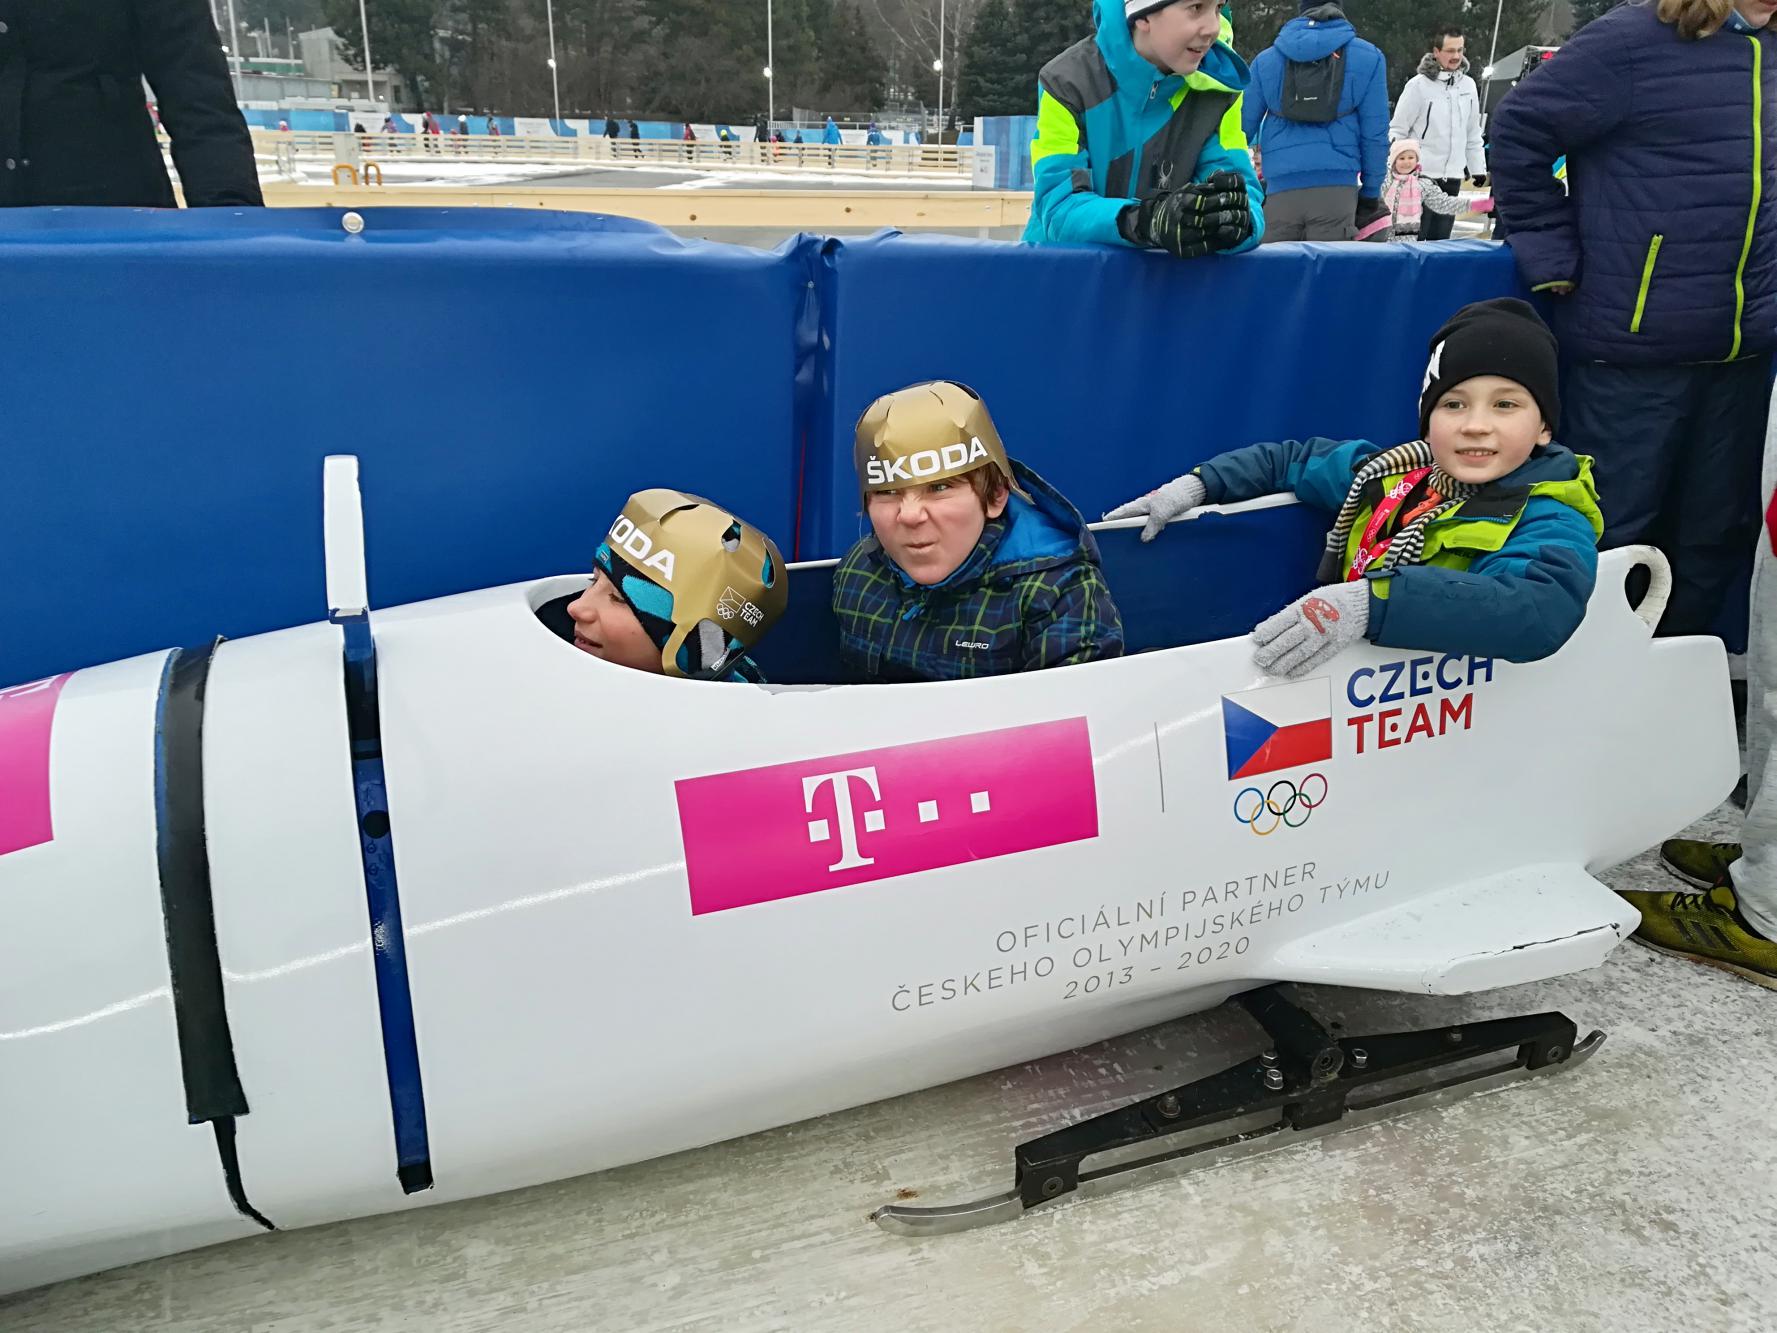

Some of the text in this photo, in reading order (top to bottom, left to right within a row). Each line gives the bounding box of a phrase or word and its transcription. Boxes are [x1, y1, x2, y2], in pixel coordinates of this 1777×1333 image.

[867, 436, 988, 484] ŠKODA
[609, 514, 675, 582] ODA
[740, 609, 758, 627] TEAM
[745, 602, 764, 621] CZECH
[955, 640, 989, 649] LEWRO
[1347, 652, 1494, 708] CZECH
[1348, 693, 1473, 754] TEAM
[996, 862, 1316, 953] OFICIÁLNÍ PARTNER
[1073, 893, 1303, 968] OLYMPIJSKÉHO
[1319, 870, 1389, 904] TÝMU
[1063, 966, 1134, 999] 2013
[1177, 936, 1249, 970] 2020
